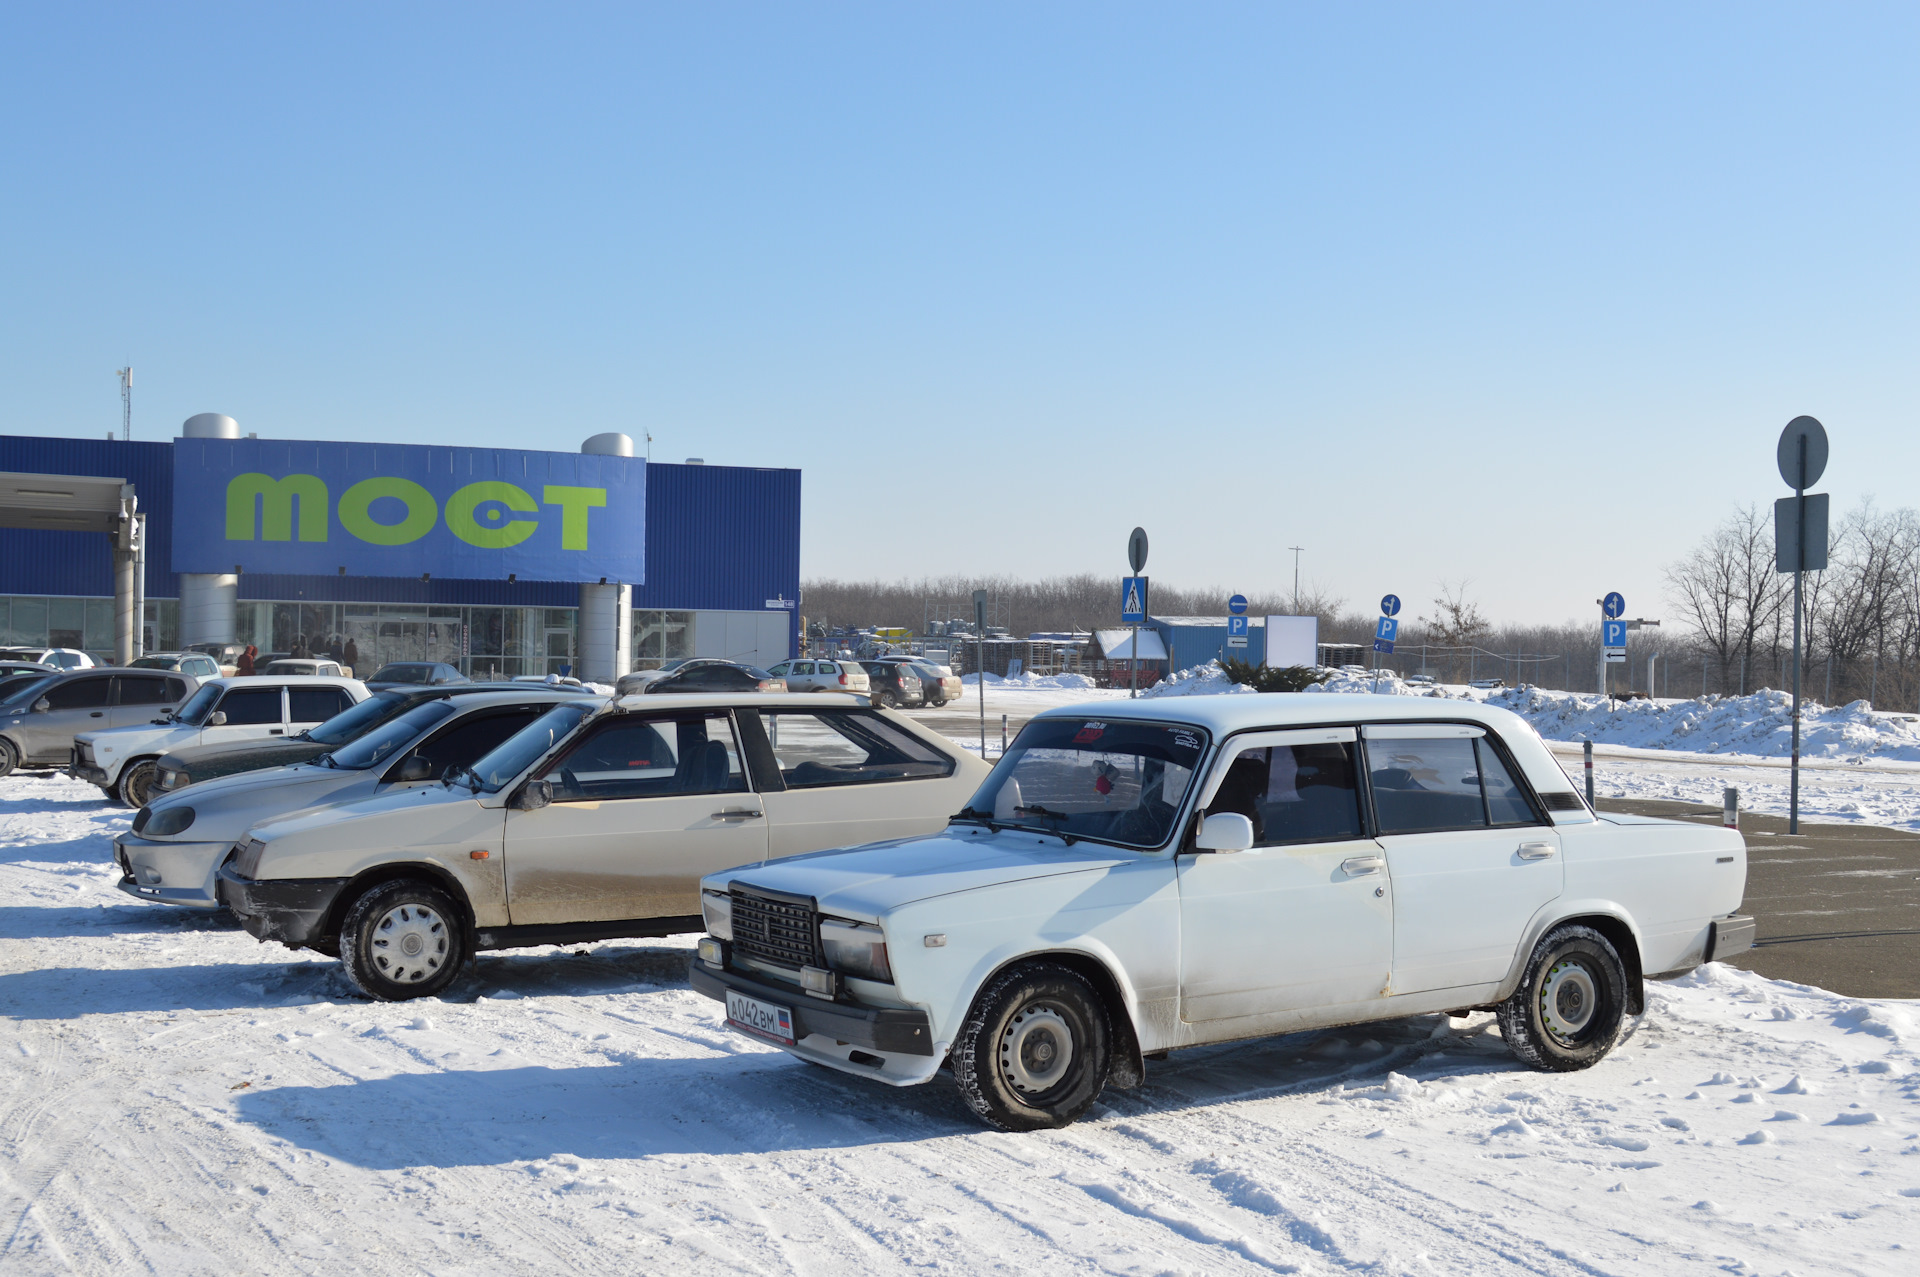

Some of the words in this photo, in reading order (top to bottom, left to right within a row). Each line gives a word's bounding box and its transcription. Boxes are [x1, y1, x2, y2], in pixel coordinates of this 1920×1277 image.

[225, 472, 607, 551] МОСТ
[1233, 619, 1243, 633] P
[1381, 620, 1393, 636] P
[1609, 624, 1620, 643] P
[732, 998, 776, 1032] A042BM
